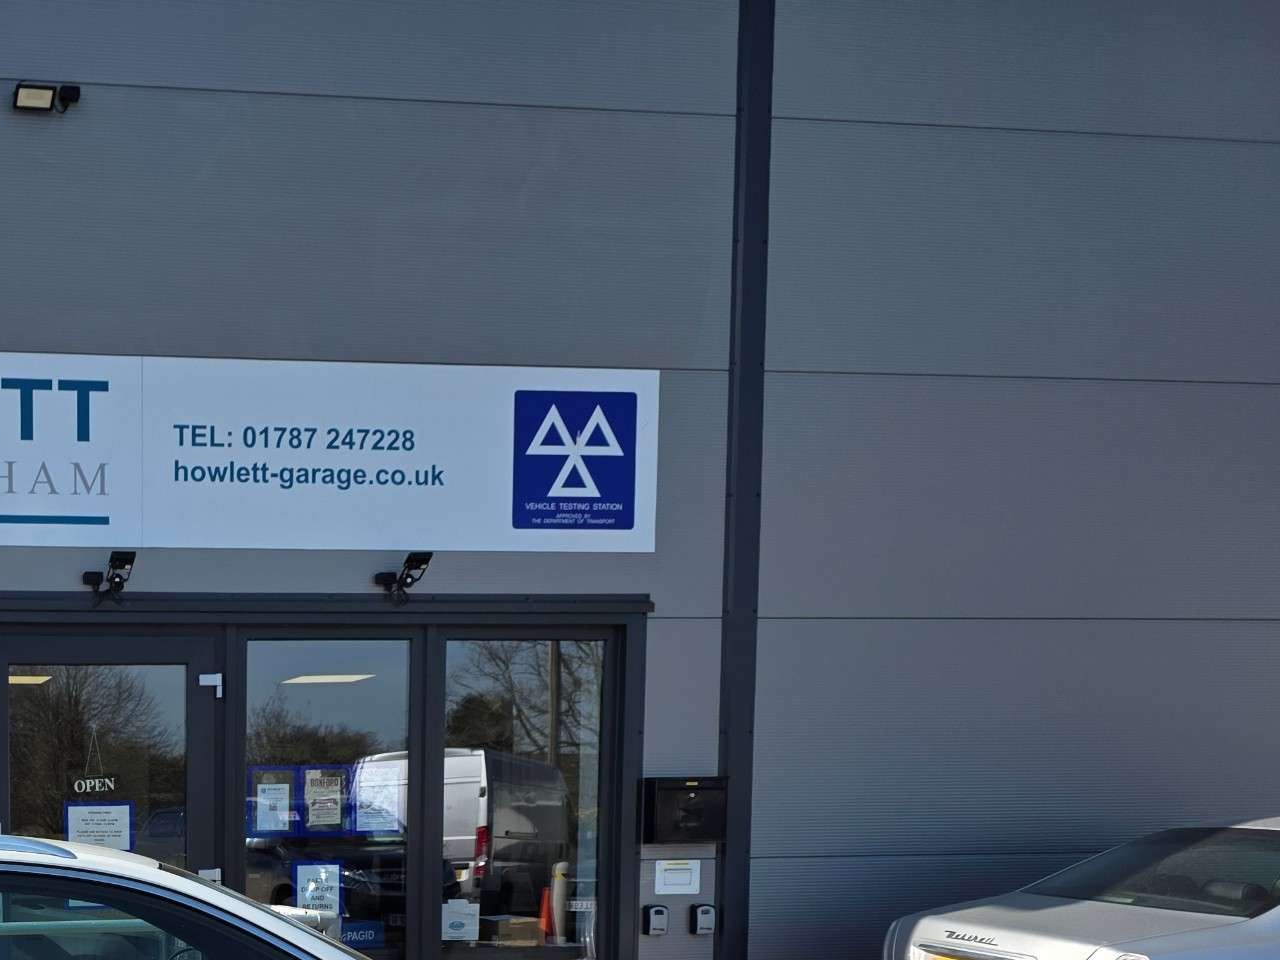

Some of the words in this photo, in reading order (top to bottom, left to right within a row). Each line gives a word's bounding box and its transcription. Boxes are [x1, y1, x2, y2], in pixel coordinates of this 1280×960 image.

[173, 424, 233, 448] TEL:
[242, 425, 318, 449] 01787
[326, 427, 415, 451] 247228
[174, 459, 445, 491] howlett-garage.co.uk
[525, 502, 557, 511] VEHICLE
[560, 502, 590, 511] TESTING
[592, 503, 623, 511] STATION
[74, 778, 115, 793] OPEN
[347, 930, 375, 941] PAGID
